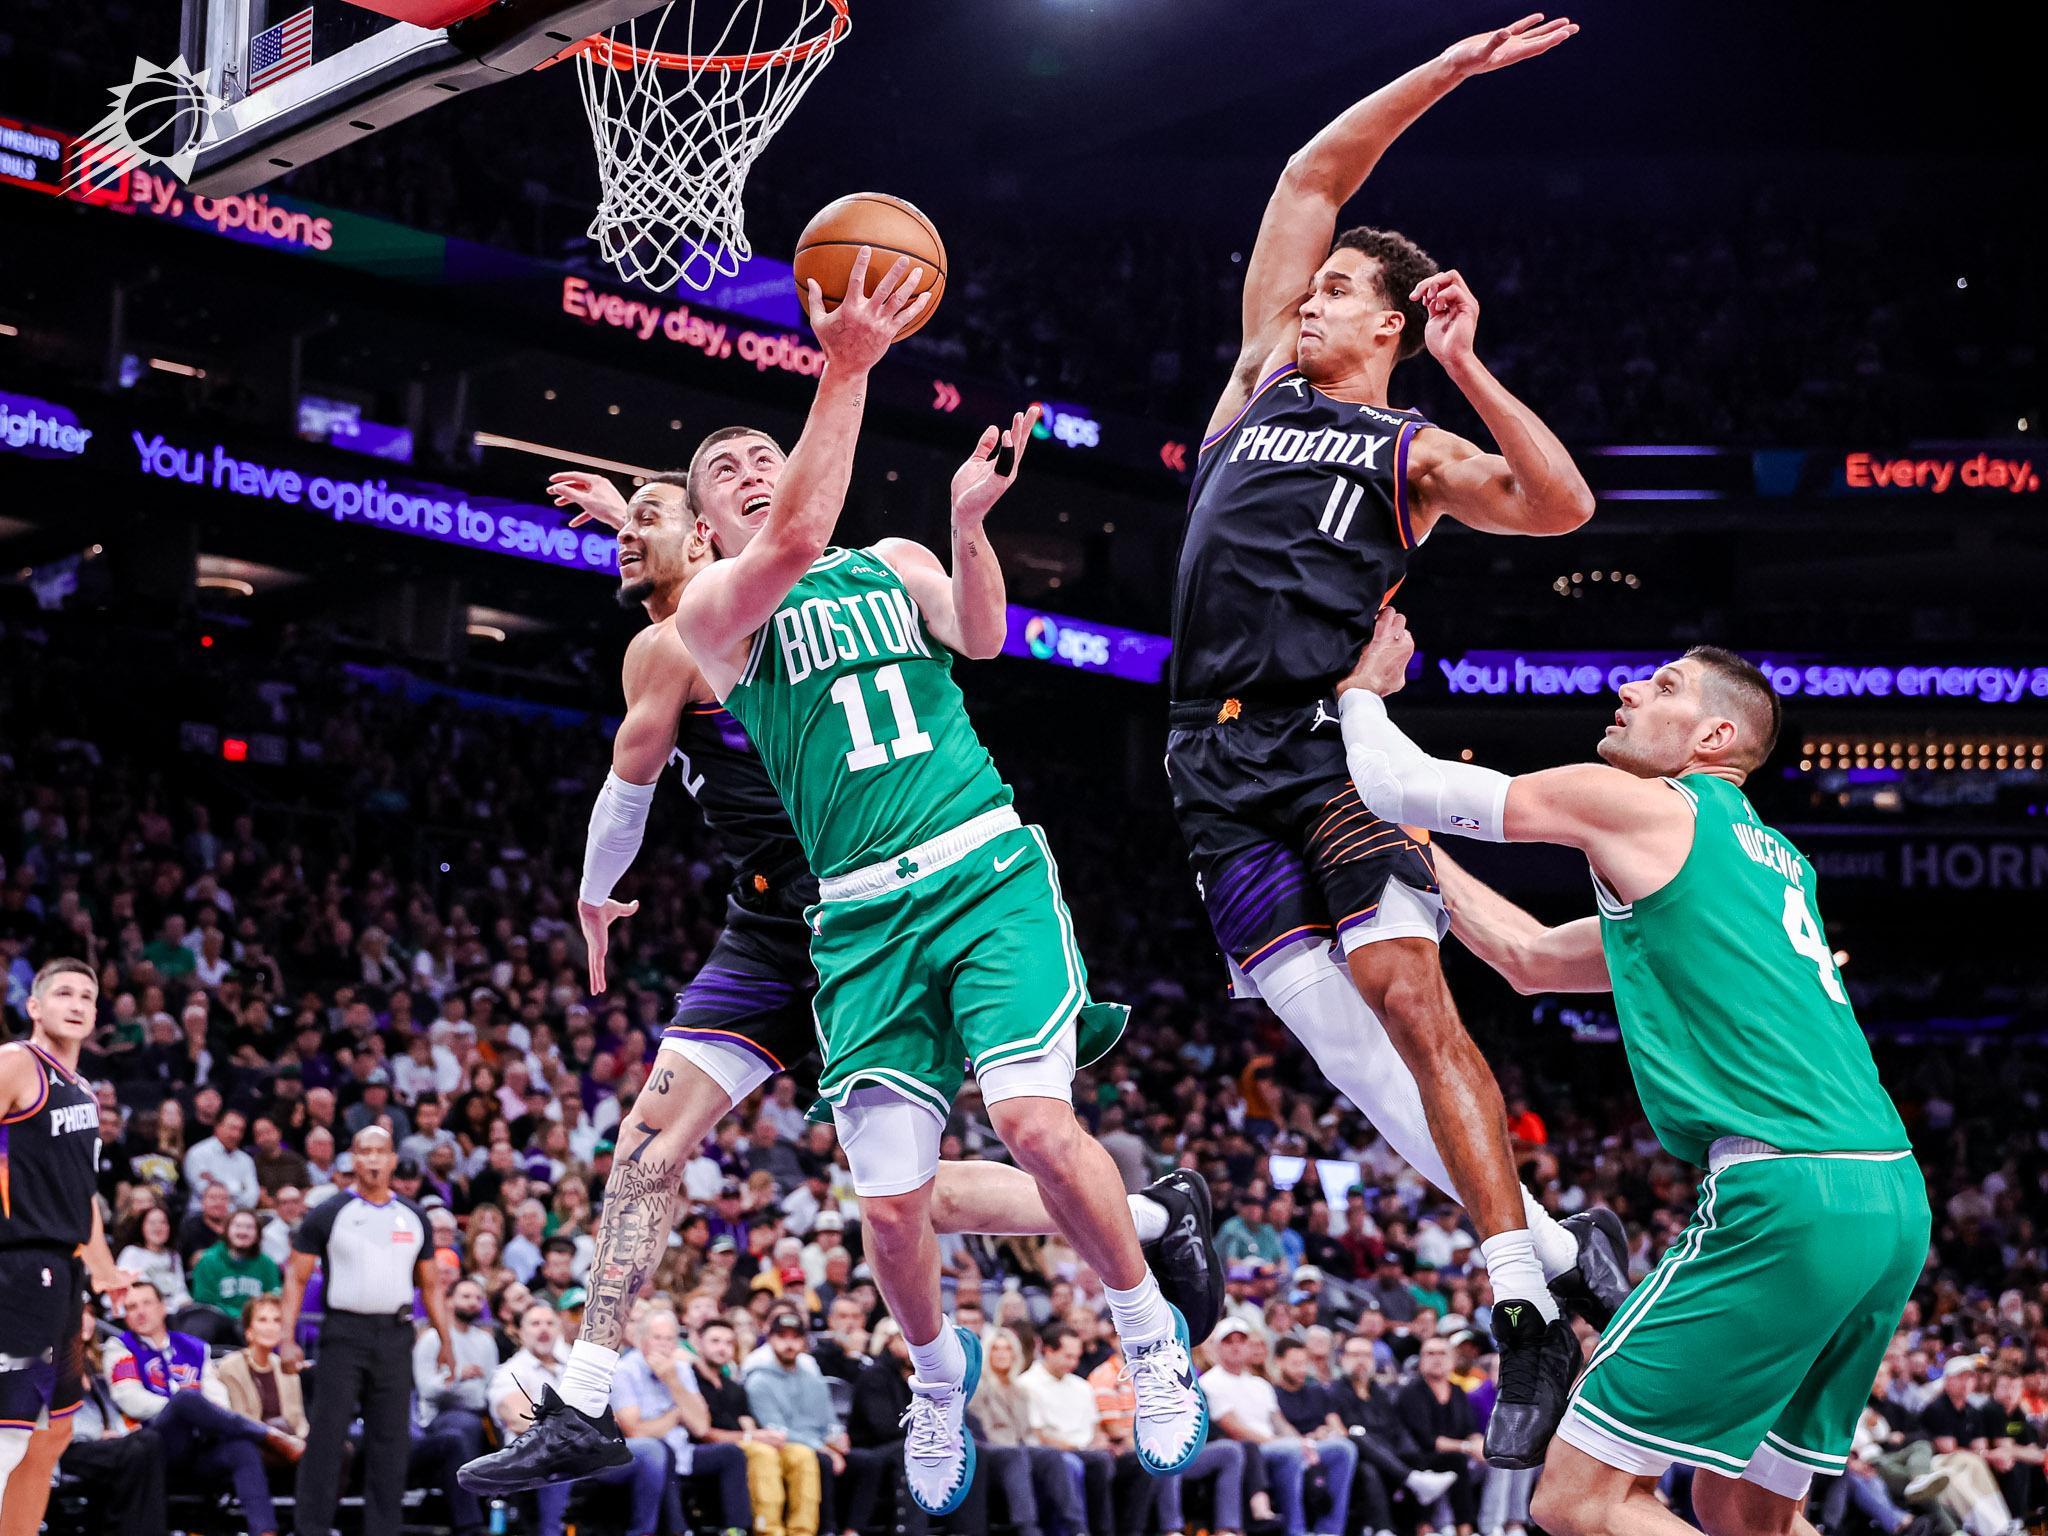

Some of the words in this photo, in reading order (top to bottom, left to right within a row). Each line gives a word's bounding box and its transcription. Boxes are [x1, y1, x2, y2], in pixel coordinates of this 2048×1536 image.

[193, 193, 333, 250] options
[563, 276, 660, 340] Every
[1359, 406, 1404, 426] PayPal
[1228, 425, 1391, 470] PHOENIX
[1846, 451, 1955, 494] Every
[132, 430, 204, 484] You
[212, 444, 302, 504] have
[308, 477, 452, 535] options
[456, 501, 495, 542] to
[498, 516, 580, 561] save
[1318, 474, 1365, 543] 11
[775, 588, 932, 686] BOSTON
[1438, 658, 1508, 694] You
[1515, 656, 1602, 695] have
[1804, 666, 1893, 696] save
[1897, 666, 2029, 703] energy
[830, 663, 934, 773] 11
[668, 746, 705, 798] 2
[1782, 884, 1848, 1005] 4
[629, 1121, 662, 1162] 7
